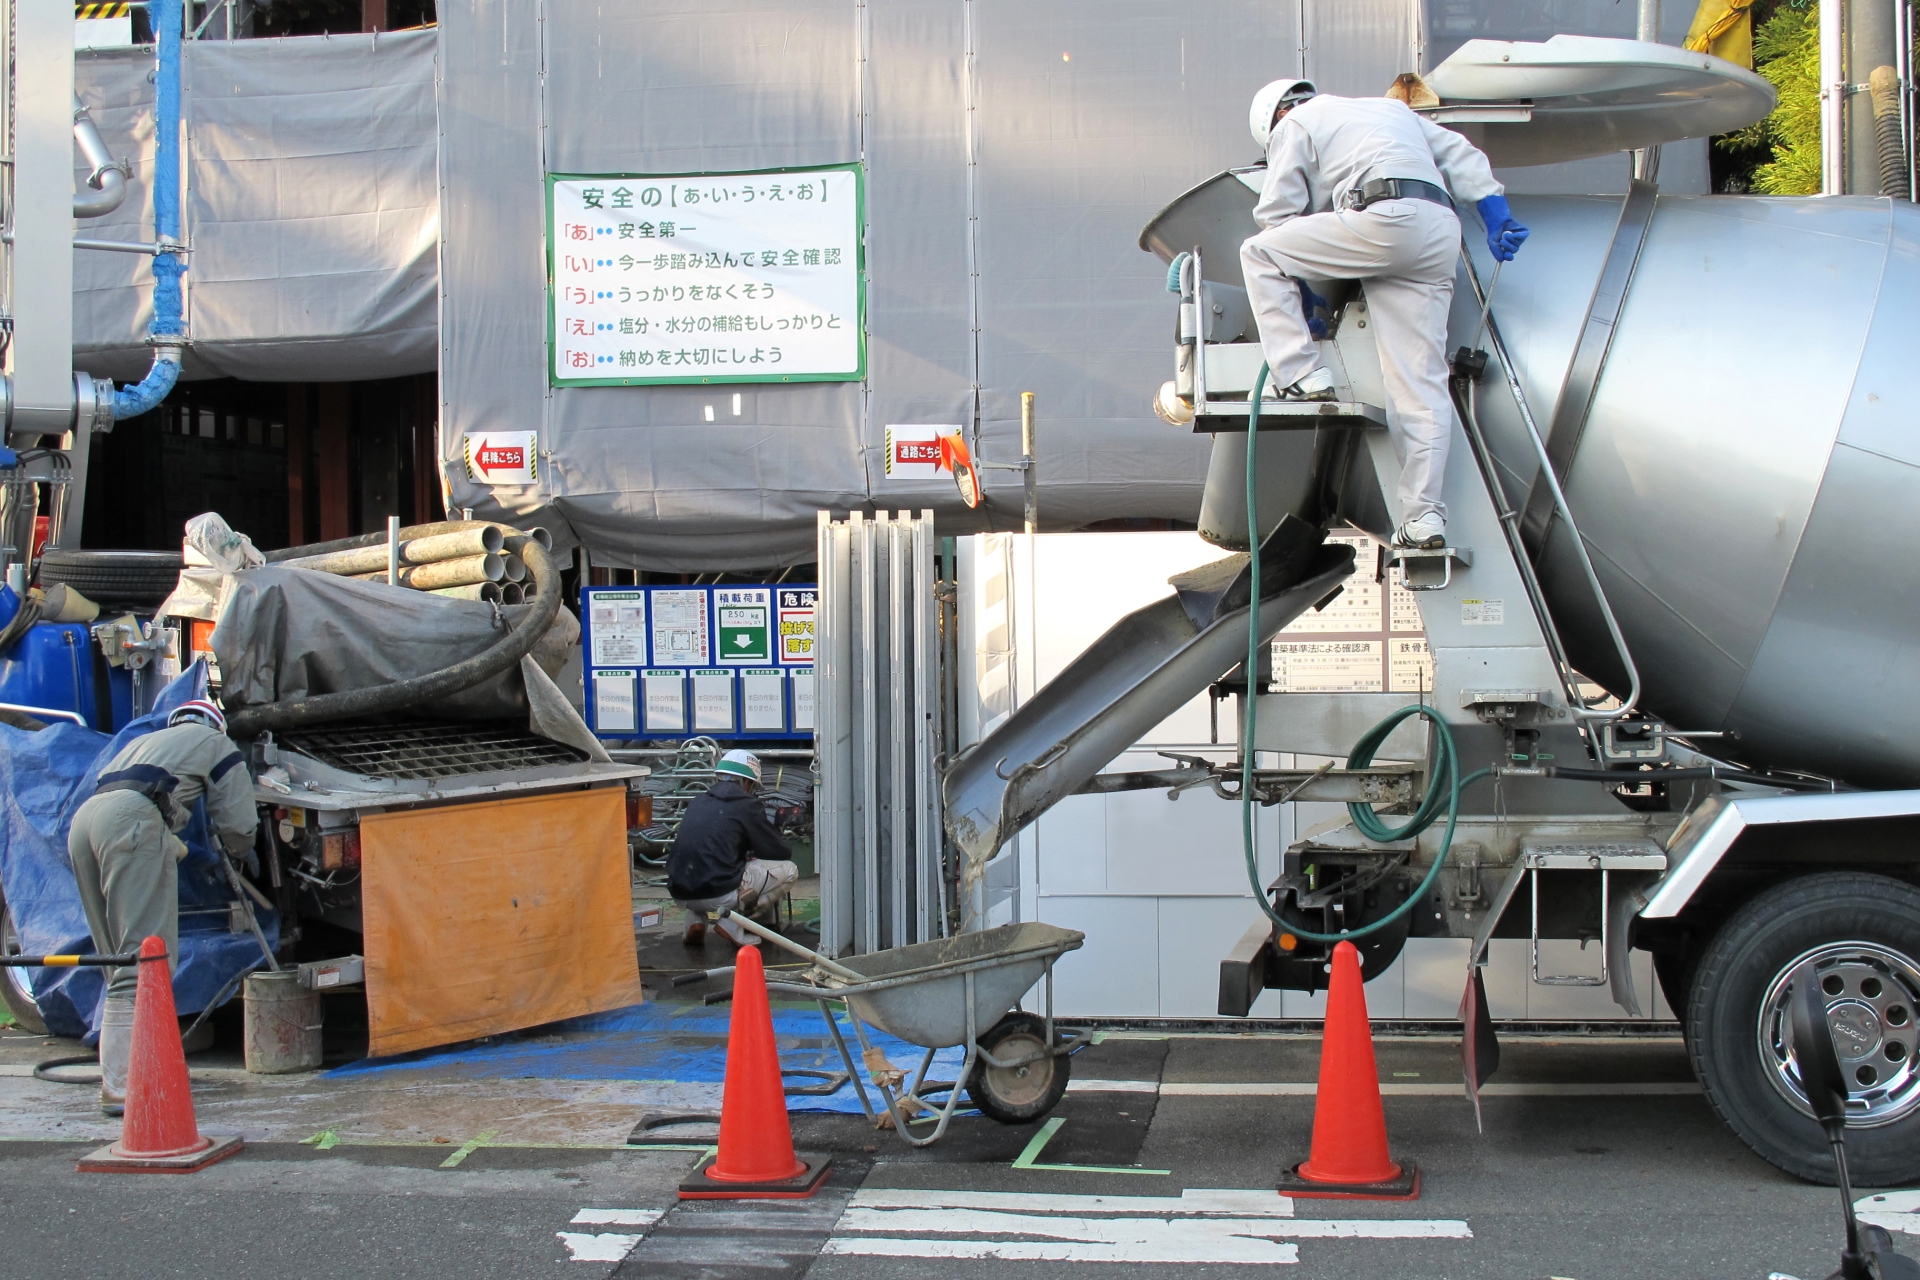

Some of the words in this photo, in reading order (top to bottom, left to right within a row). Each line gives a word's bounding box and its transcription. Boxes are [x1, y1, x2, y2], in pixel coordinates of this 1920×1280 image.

[481, 451, 521, 465] 昇降こちら
[719, 592, 765, 604] 積載荷重
[728, 610, 745, 618] 250
